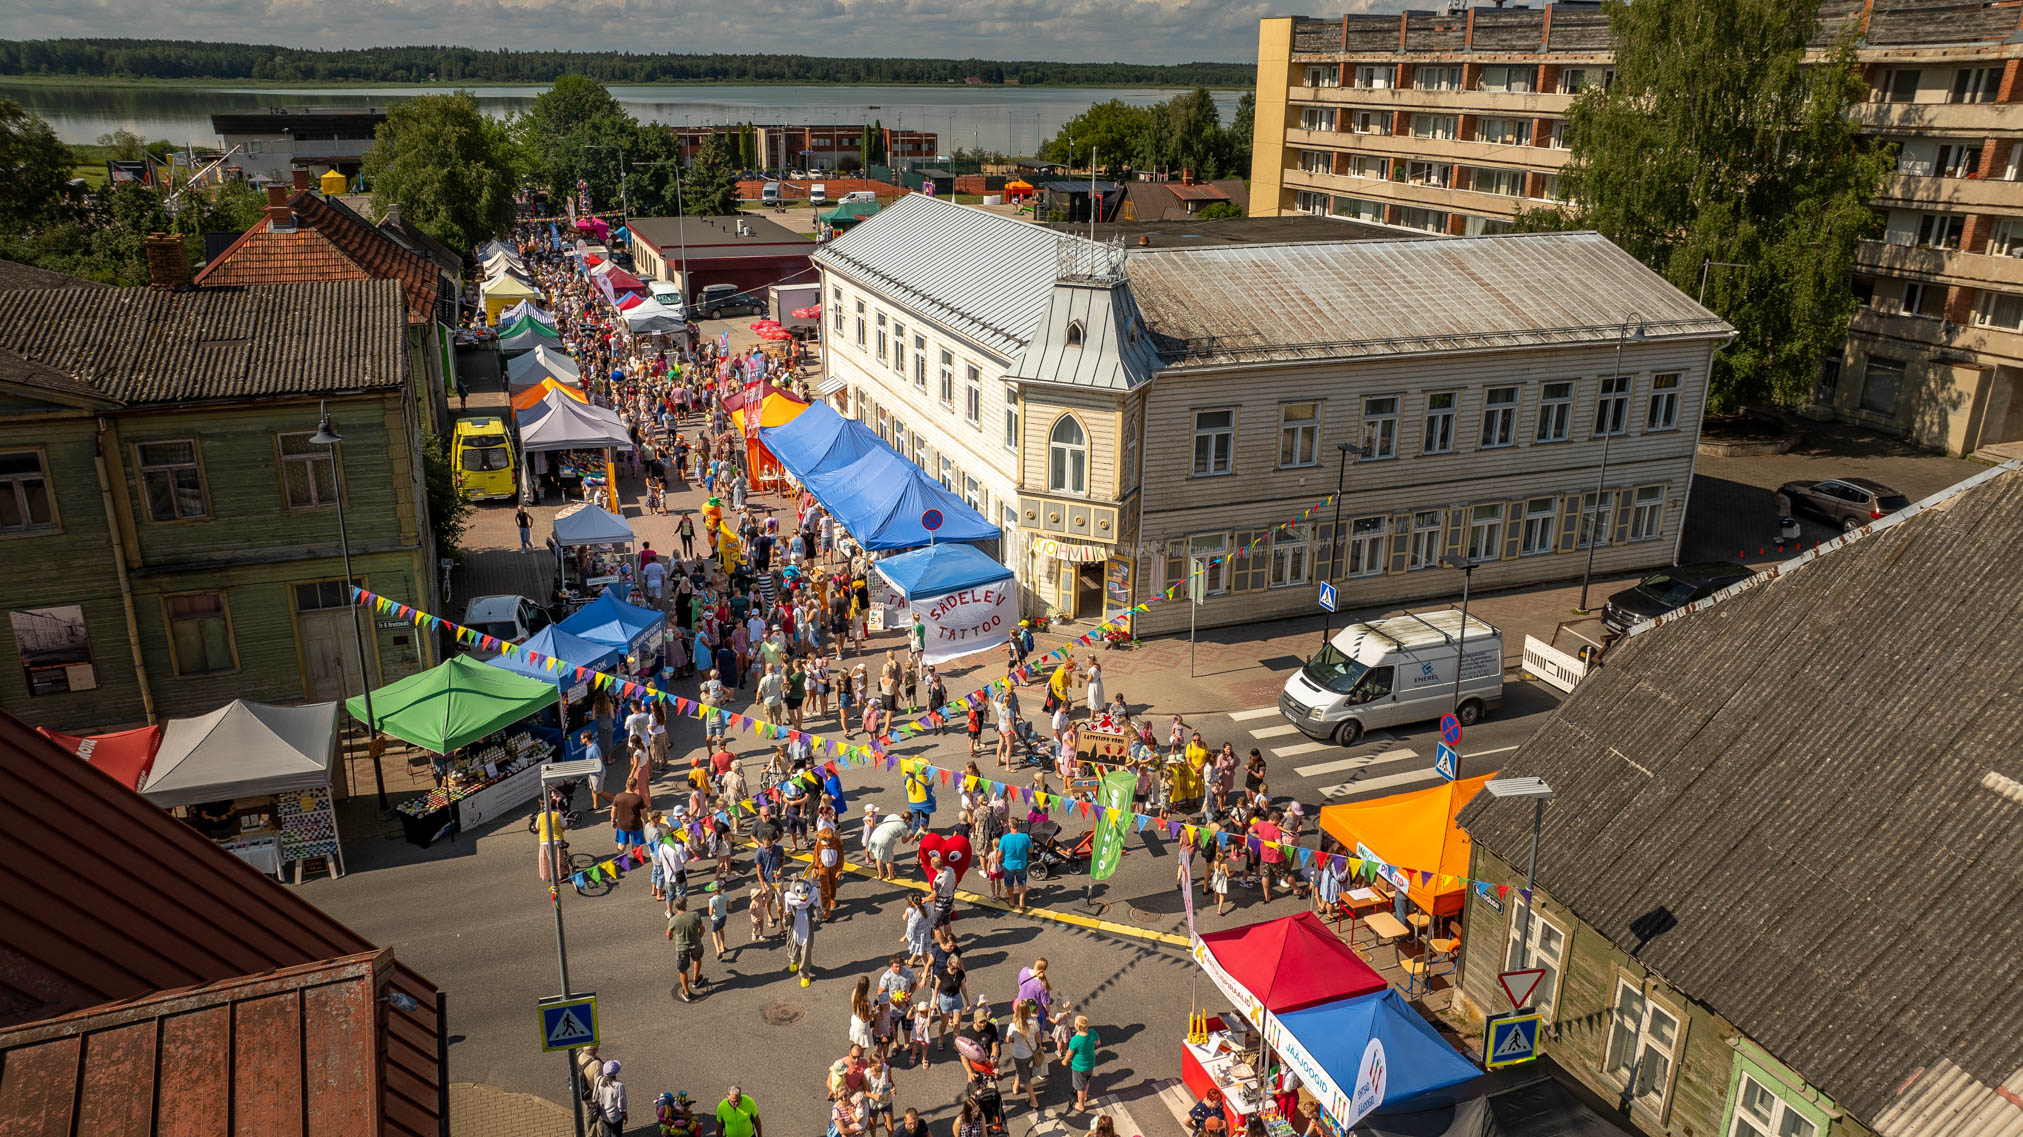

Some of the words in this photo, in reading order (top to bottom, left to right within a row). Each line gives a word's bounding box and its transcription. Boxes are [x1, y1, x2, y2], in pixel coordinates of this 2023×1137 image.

[1034, 538, 1105, 561] KOHVIK
[930, 590, 1006, 621] SÄDELEV
[938, 615, 1001, 640] TATTOO
[1414, 674, 1439, 683] ENEREL
[1358, 844, 1374, 861] INFO
[1285, 1043, 1328, 1093] JÄÄJOOGID
